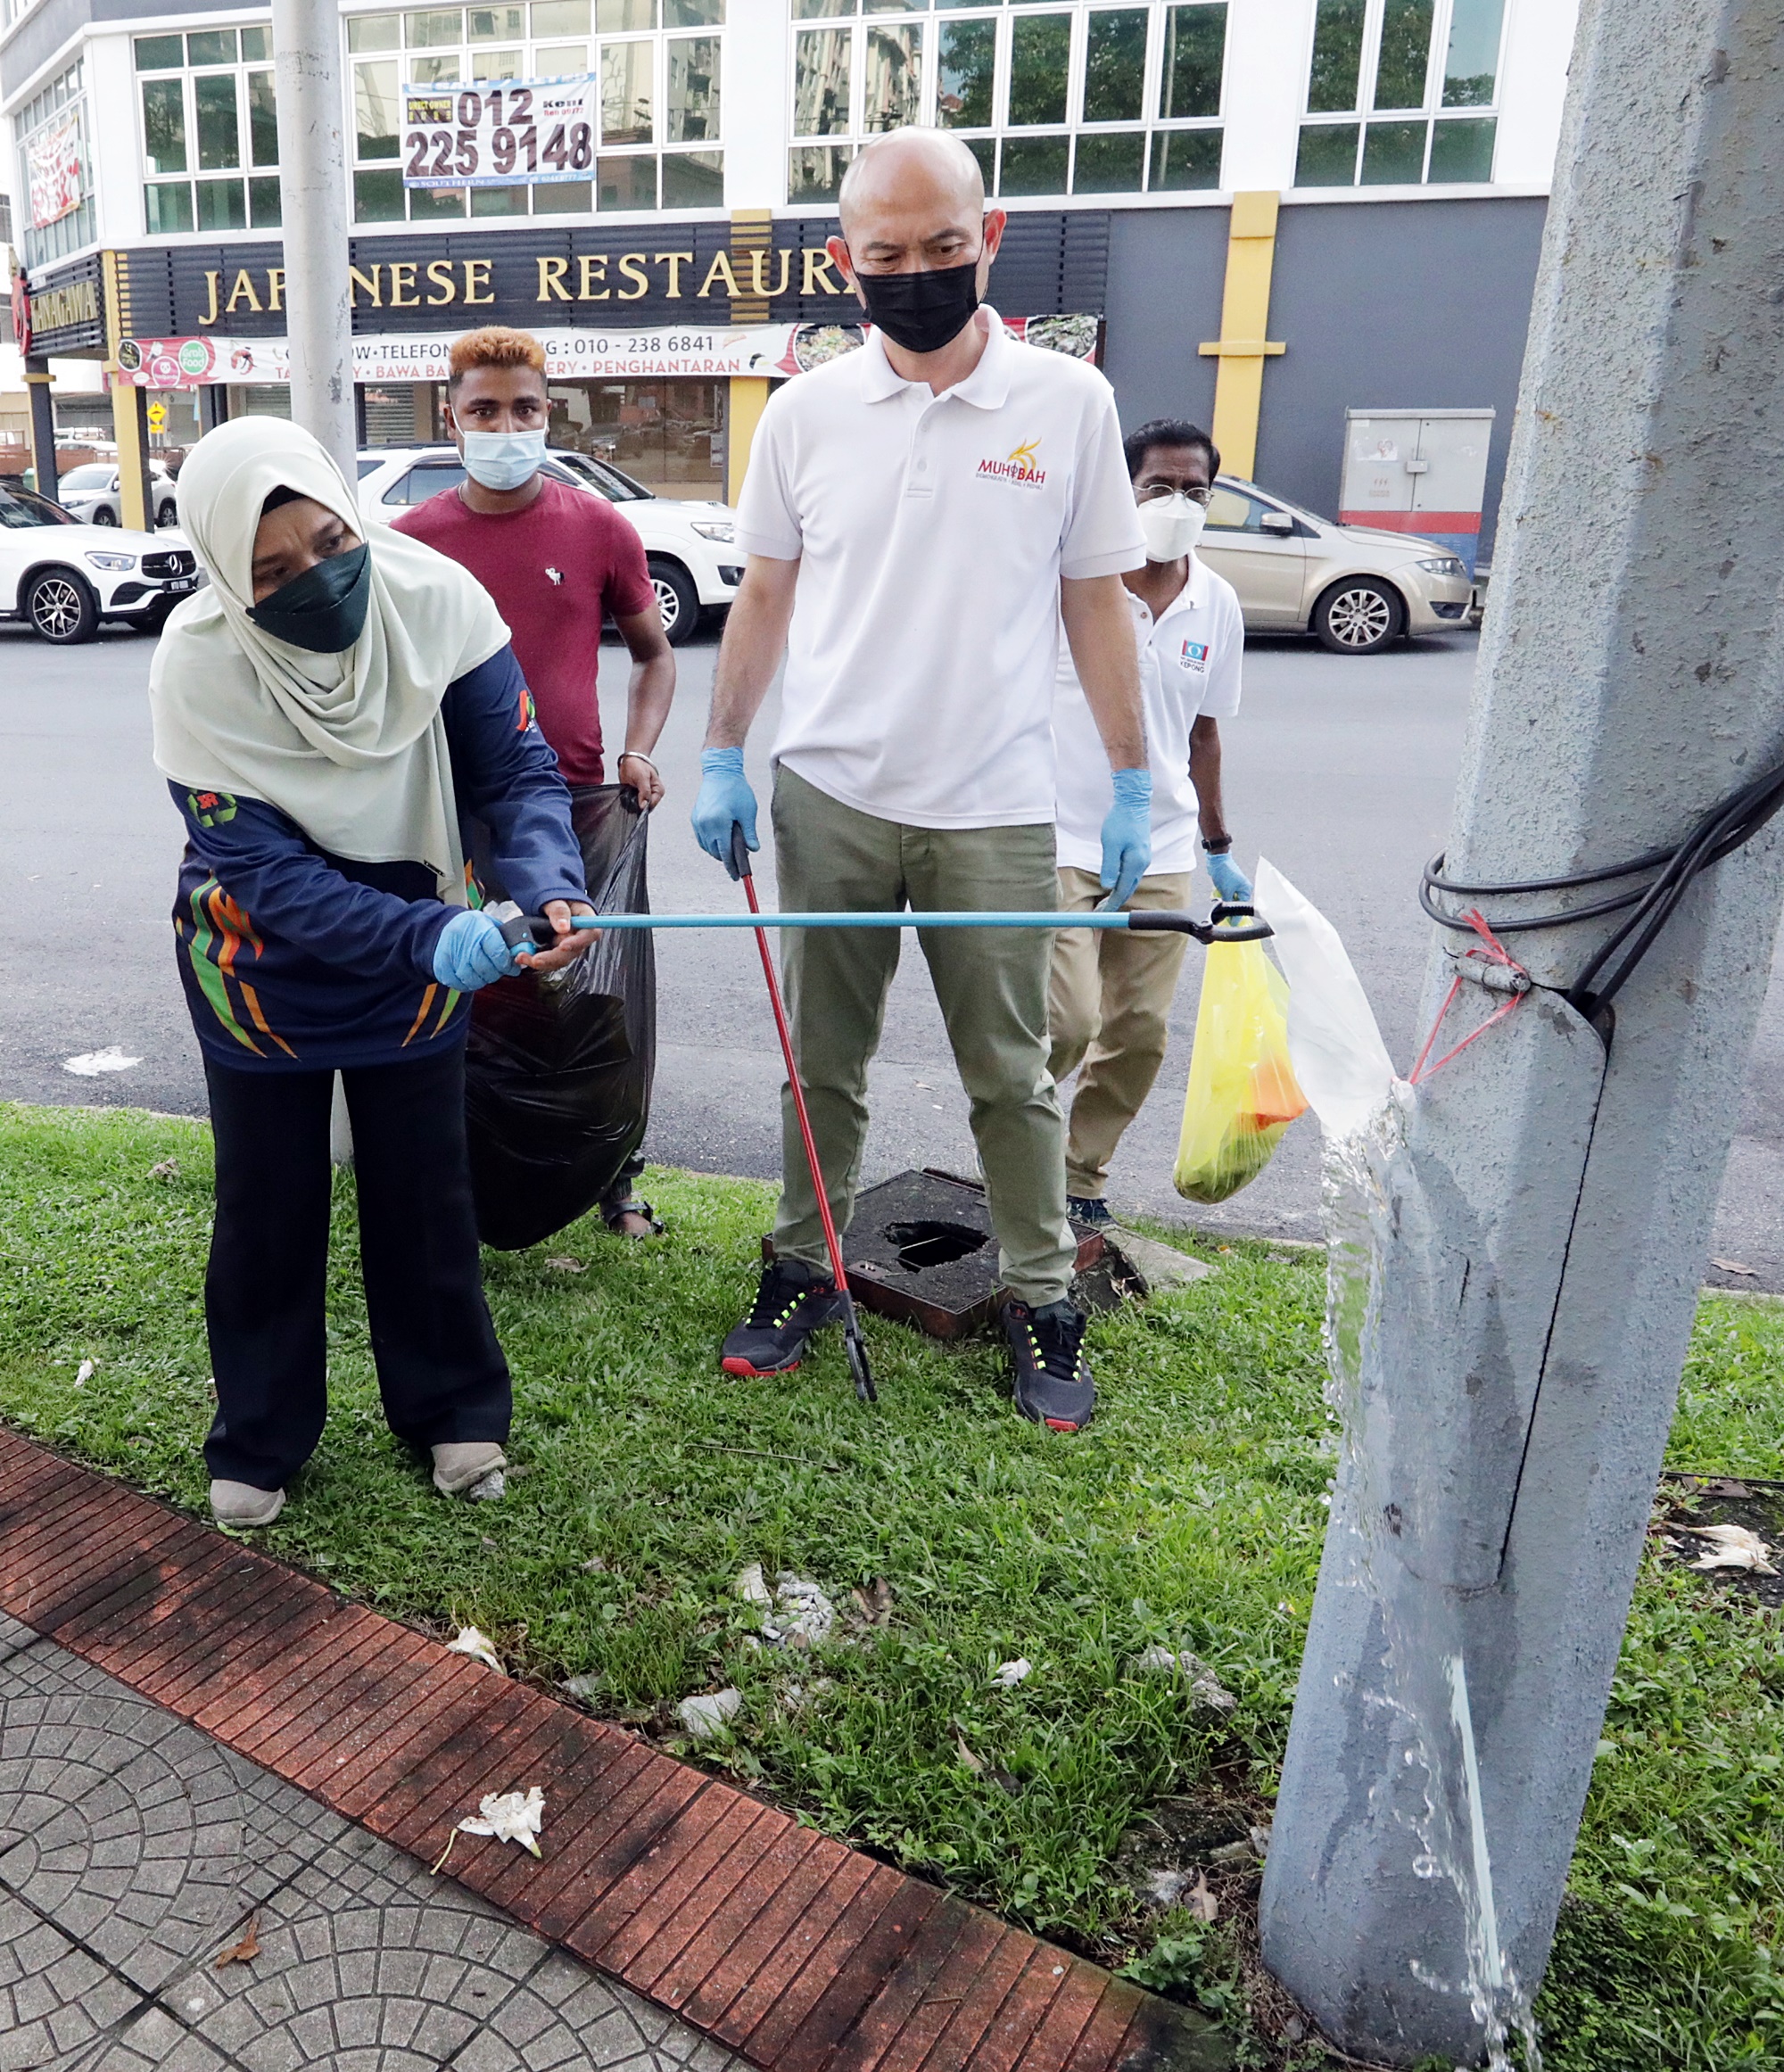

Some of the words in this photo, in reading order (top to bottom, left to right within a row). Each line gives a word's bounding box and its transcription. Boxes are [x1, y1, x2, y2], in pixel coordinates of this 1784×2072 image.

[458, 88, 533, 128] 012
[406, 128, 479, 177] 225
[491, 121, 592, 175] 9148
[198, 260, 496, 326] JAPNESE
[182, 346, 205, 358] Grab
[574, 338, 608, 354] 010
[628, 336, 661, 353] 238
[668, 335, 714, 352] 6841
[182, 357, 205, 367] Food
[376, 364, 418, 378] BAWA
[592, 358, 740, 374] PENGHANTARAN
[1179, 660, 1205, 673] KEPONG
